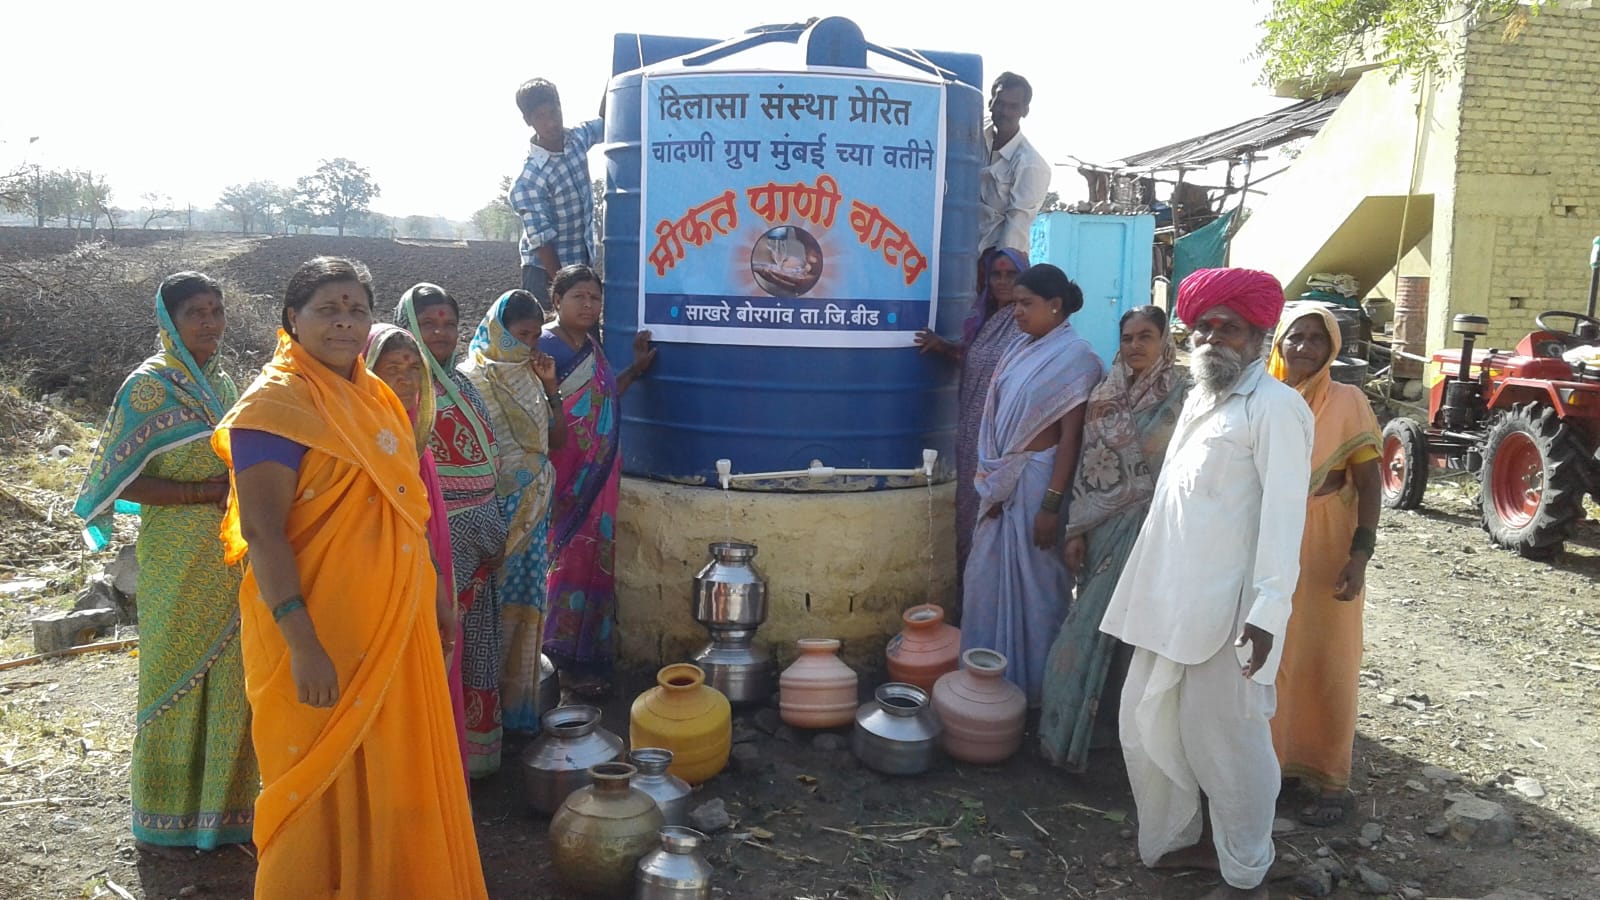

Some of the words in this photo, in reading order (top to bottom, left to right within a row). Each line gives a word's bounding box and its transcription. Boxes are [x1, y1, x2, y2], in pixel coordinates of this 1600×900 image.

[658, 84, 749, 121] दिलासा
[760, 83, 838, 121] संस्था
[848, 85, 912, 126] प्रेरित
[652, 131, 716, 164] चांदणी
[724, 140, 761, 170] ग्रुप
[770, 132, 827, 171] मुंबई
[835, 143, 875, 167] च्या
[882, 138, 934, 171] वतीने
[745, 173, 843, 229] पाणी
[849, 199, 928, 286] वाटप
[685, 300, 730, 322] साखरे
[736, 301, 794, 324] बोरगांव
